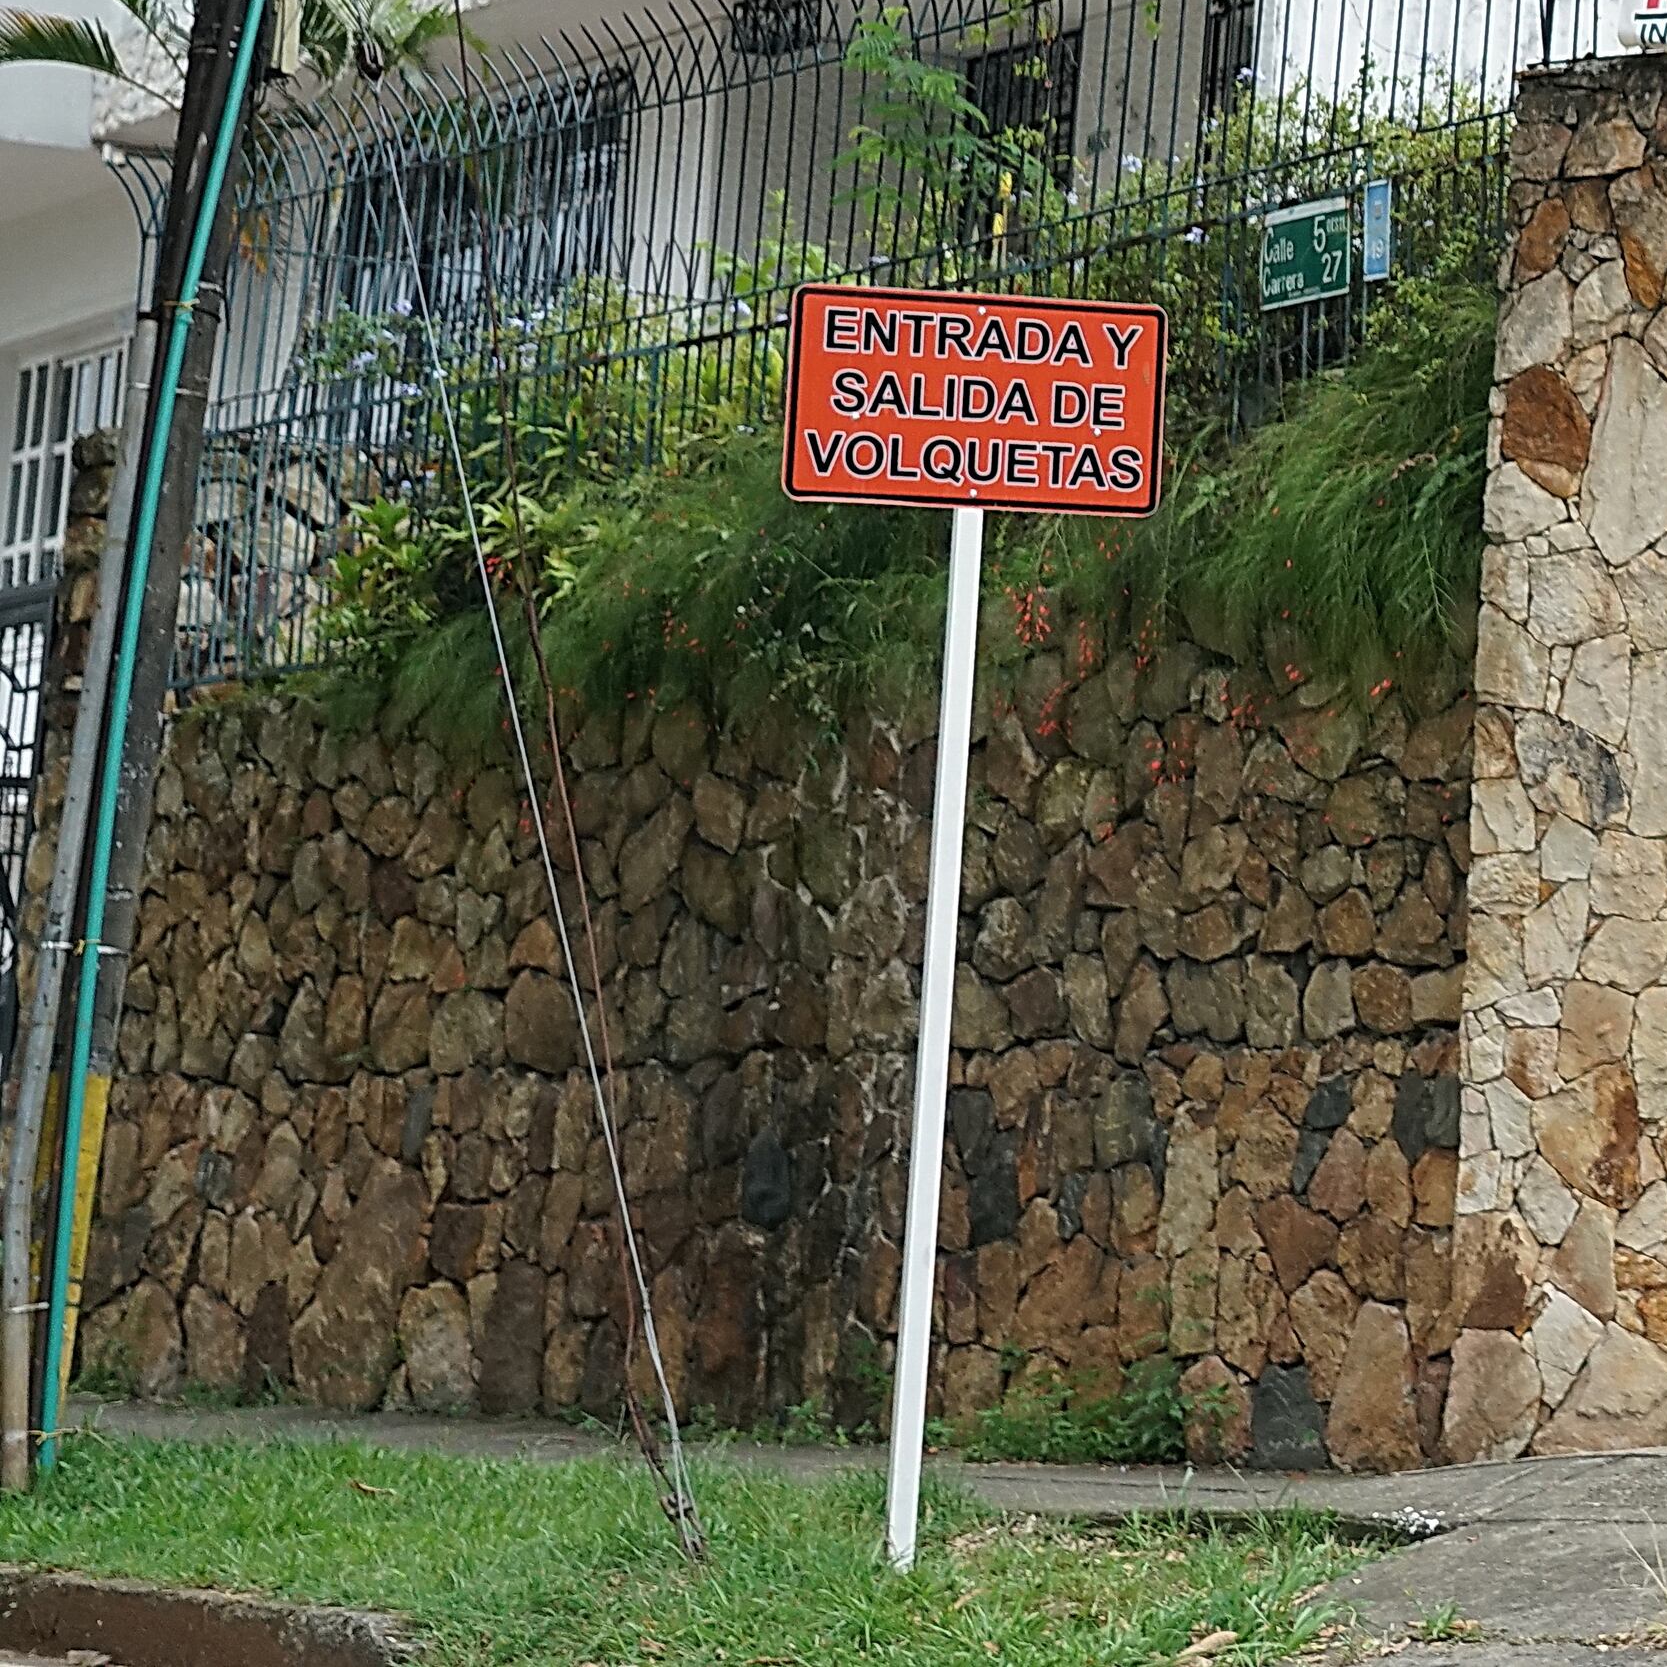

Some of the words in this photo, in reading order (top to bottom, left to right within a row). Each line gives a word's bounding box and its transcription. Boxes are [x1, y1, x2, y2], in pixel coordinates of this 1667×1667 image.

[1263, 227, 1295, 264] Calle
[1313, 215, 1327, 254] 5
[1263, 266, 1304, 298] Carrera
[1321, 250, 1343, 284] 27
[823, 305, 1093, 368] ENTRADA
[1102, 323, 1144, 370] Y
[830, 368, 1039, 426] SALIDA
[1051, 380, 1126, 431] DE
[804, 428, 1144, 494] VOLQUETAS
